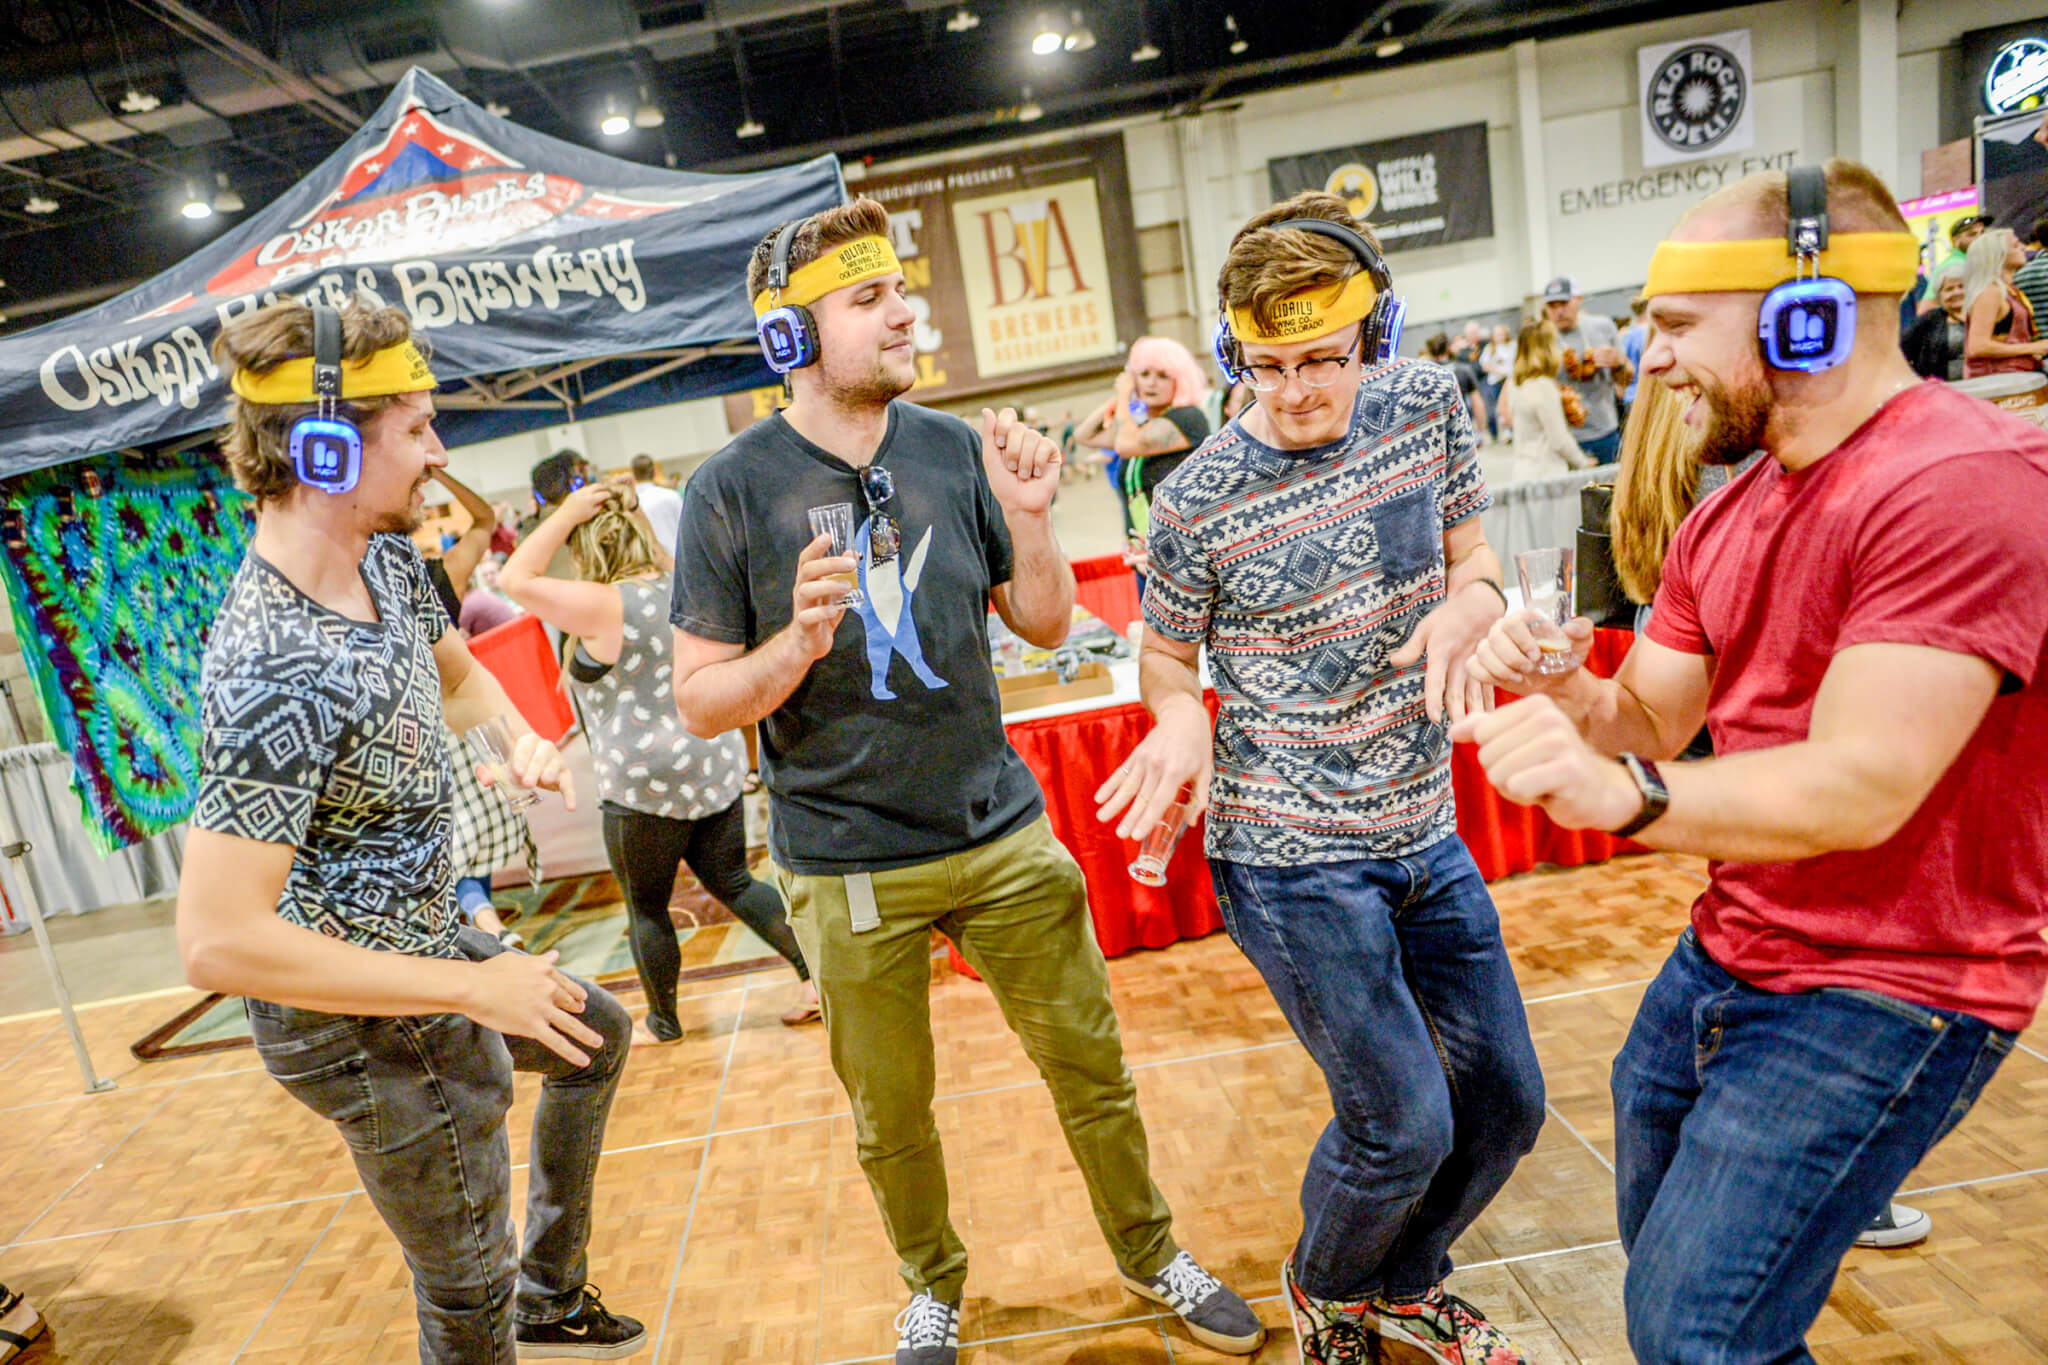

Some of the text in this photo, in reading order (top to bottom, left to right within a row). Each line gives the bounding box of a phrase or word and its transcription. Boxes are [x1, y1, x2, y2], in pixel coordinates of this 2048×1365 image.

[1655, 52, 1738, 117] RED ROCK
[1669, 113, 1728, 145] DELI
[867, 178, 944, 201] SSOCIATION
[1379, 167, 1437, 195] WILD
[1559, 163, 1729, 217] EMERGENCY
[40, 325, 219, 410] OSKAR
[391, 238, 648, 330] BREWERY
[988, 301, 1098, 343] BREWERS
[1273, 300, 1313, 320] LIDAILY
